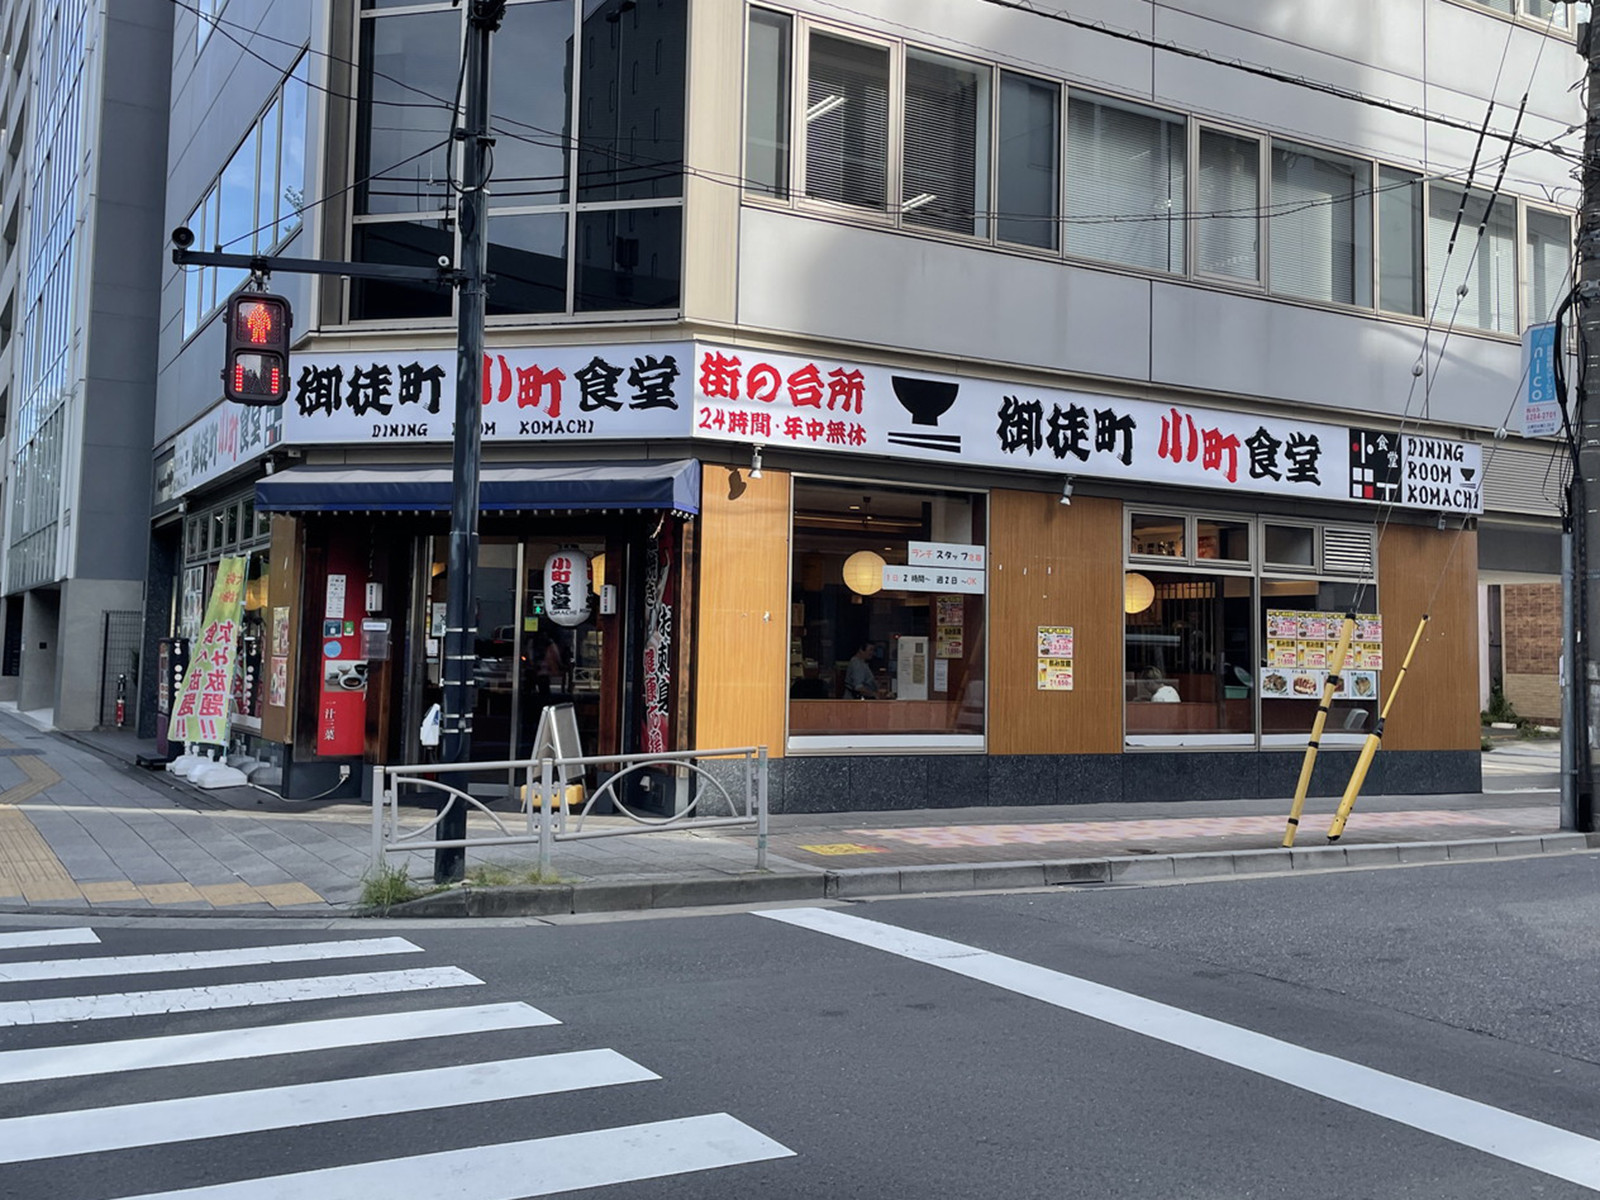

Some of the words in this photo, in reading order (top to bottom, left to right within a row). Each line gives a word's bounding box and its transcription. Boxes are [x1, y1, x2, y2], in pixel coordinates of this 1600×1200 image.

[295, 361, 446, 418] 御徒町
[699, 351, 867, 415] 街の台所
[371, 423, 429, 438] DINING
[519, 419, 595, 436] KOMACHI
[996, 395, 1137, 466] 御徒町
[1157, 407, 1323, 487] 小町食堂
[1407, 438, 1464, 463] DINING
[1407, 461, 1452, 484] ROOM
[1407, 484, 1479, 509] KOMACHI
[911, 548, 932, 558] ランチ
[551, 557, 571, 610] 小町食堂
